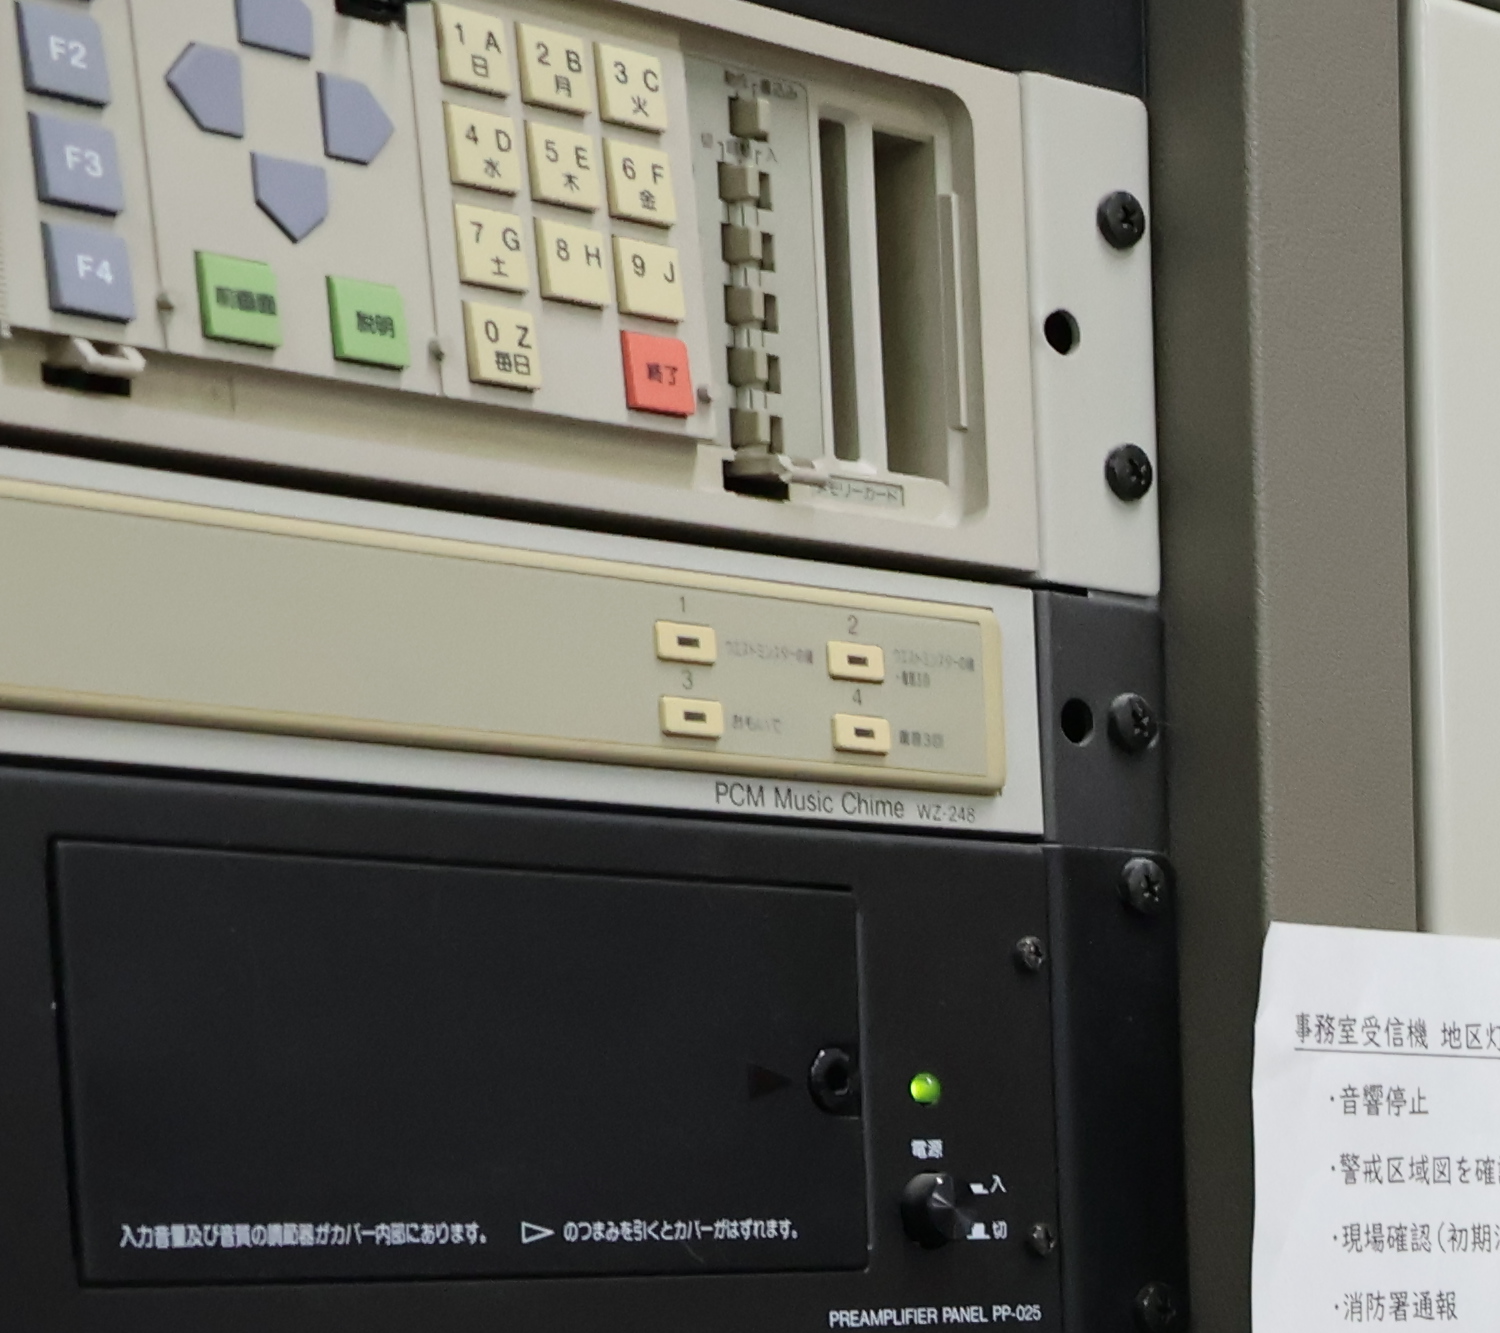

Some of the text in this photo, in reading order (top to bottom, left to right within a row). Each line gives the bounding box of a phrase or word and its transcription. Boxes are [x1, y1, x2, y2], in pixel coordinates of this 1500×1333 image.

[454, 23, 502, 53] 1 A
[49, 34, 88, 70] F2
[536, 42, 582, 73] 2 B
[472, 55, 489, 78] 日
[614, 61, 659, 92] 3 C
[554, 75, 572, 97] 月
[631, 96, 650, 118] 火
[465, 124, 512, 152] 4 D
[65, 145, 103, 178] F3
[545, 140, 590, 170] 5 E
[484, 158, 502, 179] 水
[623, 158, 664, 184] 6 F
[563, 173, 580, 191] 木
[639, 189, 657, 211] 金
[470, 222, 521, 252] 7 G
[557, 240, 601, 266] 8 H
[76, 254, 113, 284] F4
[490, 256, 508, 278] 土
[631, 254, 675, 283] 9 J
[484, 320, 532, 348] 0 Z
[495, 351, 530, 376] 毎日
[646, 361, 678, 386] 終了
[680, 597, 686, 612] 1
[848, 615, 858, 635] 2
[682, 670, 694, 690] 3
[852, 688, 862, 705] 4
[716, 782, 765, 808] PCM
[774, 787, 834, 814] Music
[842, 792, 904, 818] Chime
[1294, 1012, 1429, 1050] 事務室受信機
[990, 1174, 1007, 1194] 入
[992, 1220, 1008, 1240] 切
[829, 1304, 1042, 1328] PREAMPLIFIER PANEL PP-025
